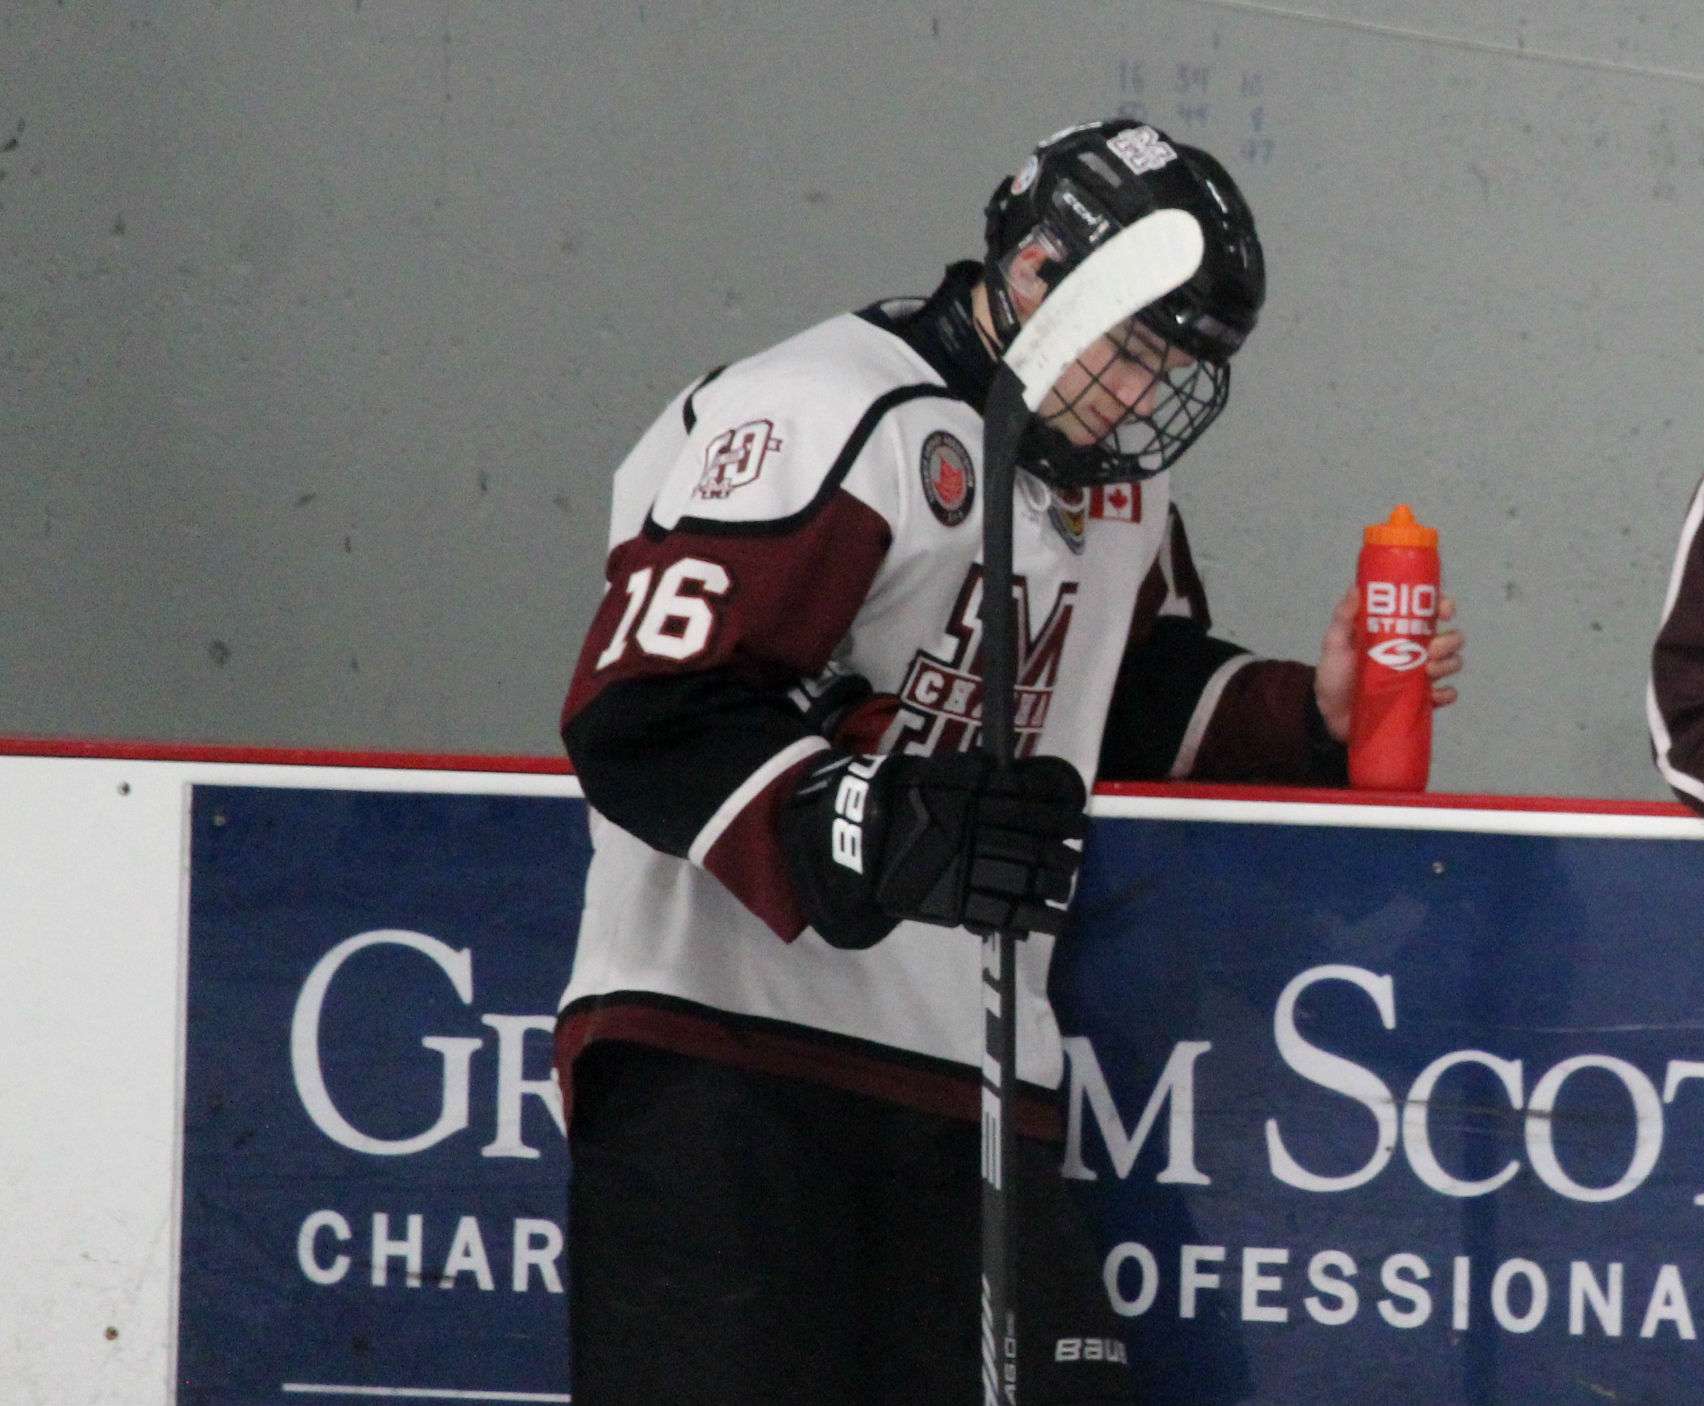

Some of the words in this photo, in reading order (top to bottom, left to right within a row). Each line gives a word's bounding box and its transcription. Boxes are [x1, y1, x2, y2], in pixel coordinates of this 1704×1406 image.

[595, 557, 732, 670] 16
[1366, 581, 1438, 617] BIO
[1366, 617, 1437, 636] STEEL
